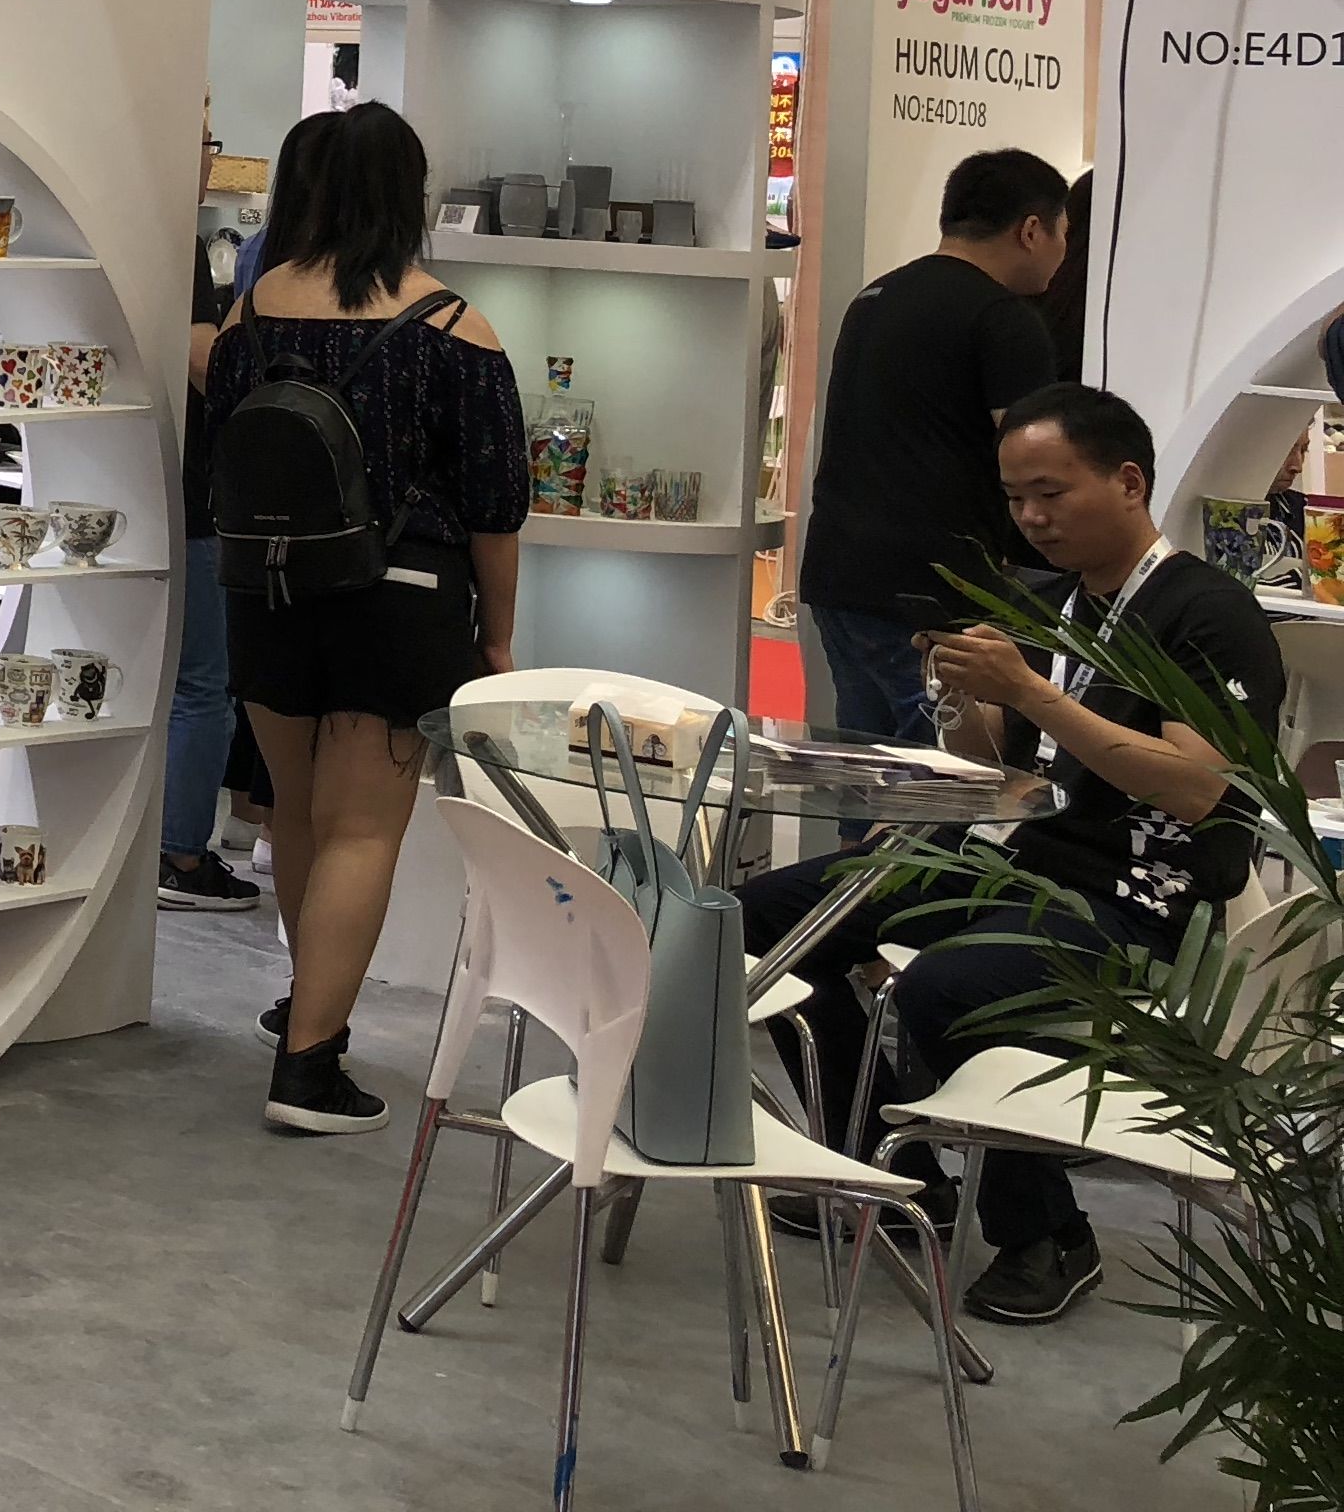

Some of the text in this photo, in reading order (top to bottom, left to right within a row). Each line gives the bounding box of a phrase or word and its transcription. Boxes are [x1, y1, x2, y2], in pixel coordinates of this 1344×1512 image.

[951, 11, 980, 25] PREMIUM
[896, 38, 978, 81] HURUM
[893, 94, 987, 128] NO:E4D108
